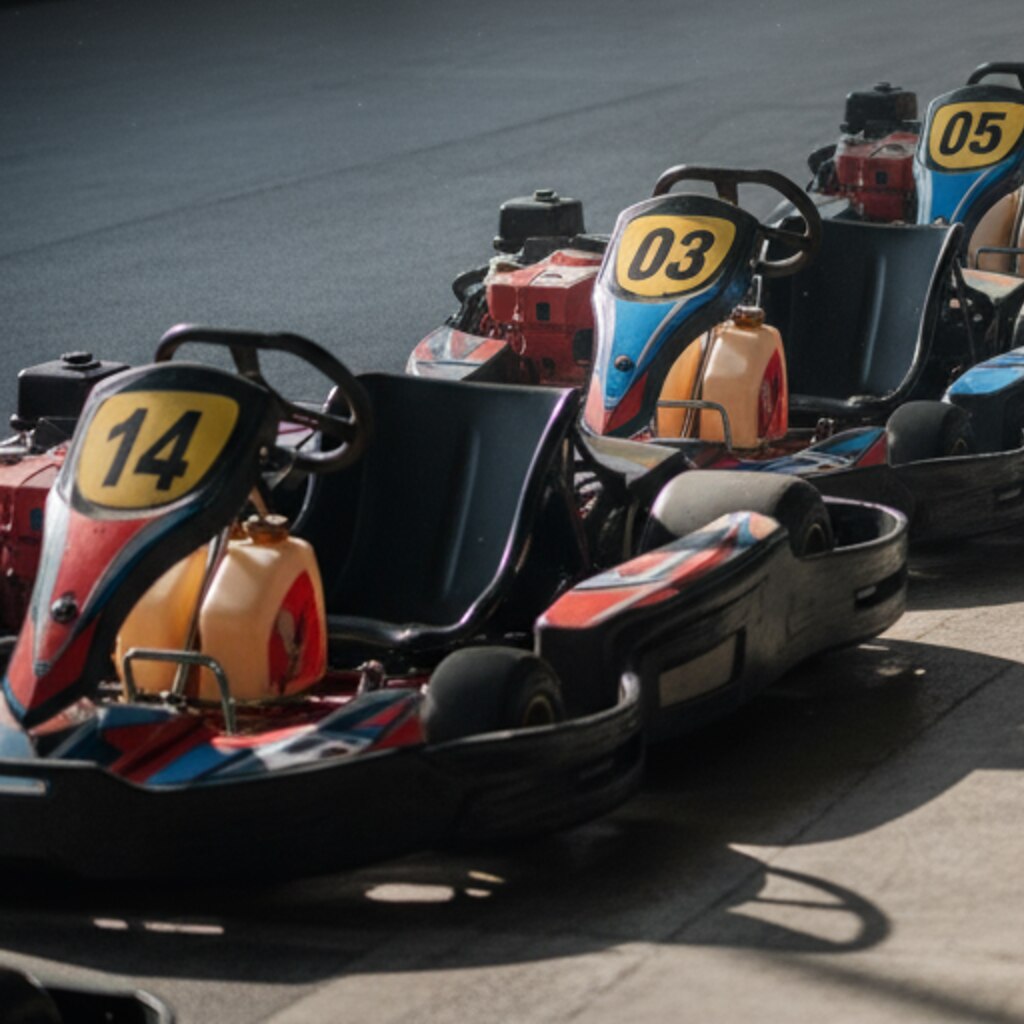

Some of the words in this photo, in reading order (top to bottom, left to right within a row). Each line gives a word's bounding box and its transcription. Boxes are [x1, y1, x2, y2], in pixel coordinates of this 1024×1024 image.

[939, 111, 1007, 155] 05
[627, 227, 715, 280] 03
[102, 408, 203, 491] 14
